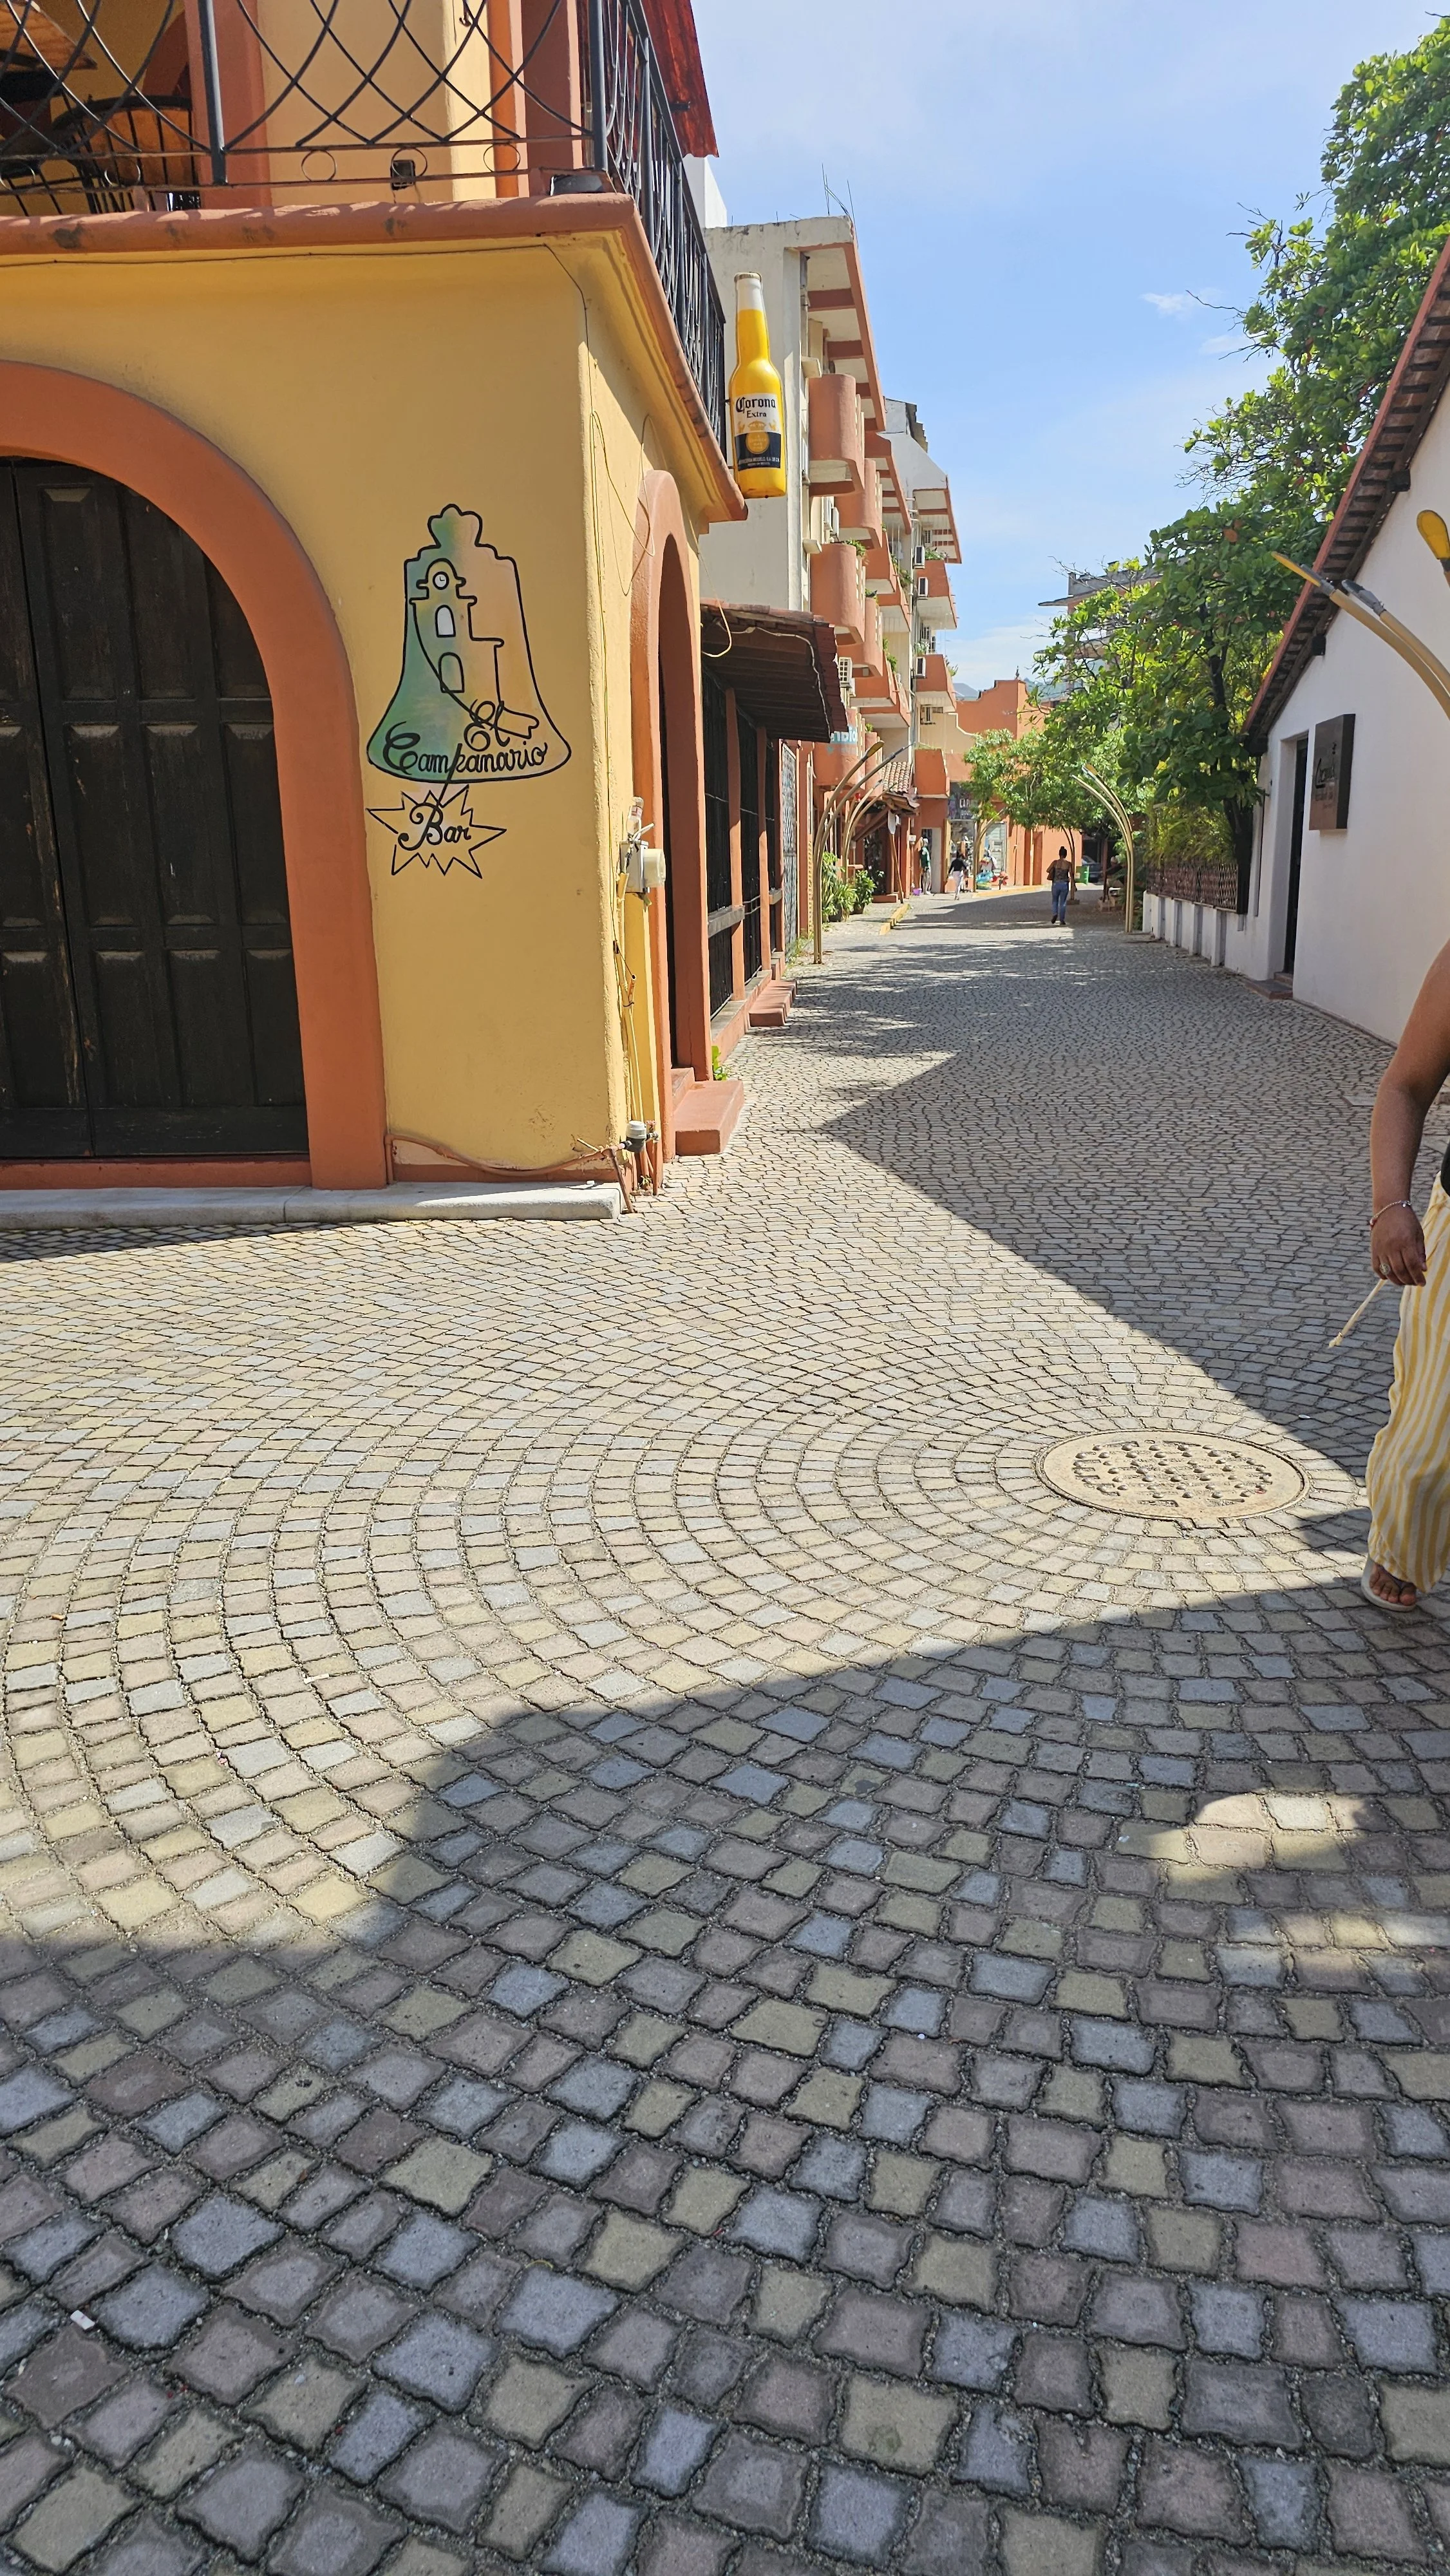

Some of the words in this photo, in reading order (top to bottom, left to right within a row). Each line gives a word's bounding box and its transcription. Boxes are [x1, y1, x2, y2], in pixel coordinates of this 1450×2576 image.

[736, 397, 776, 413] Corona
[382, 721, 548, 777] Campanario
[464, 699, 511, 752] El
[397, 802, 471, 851] Bar
